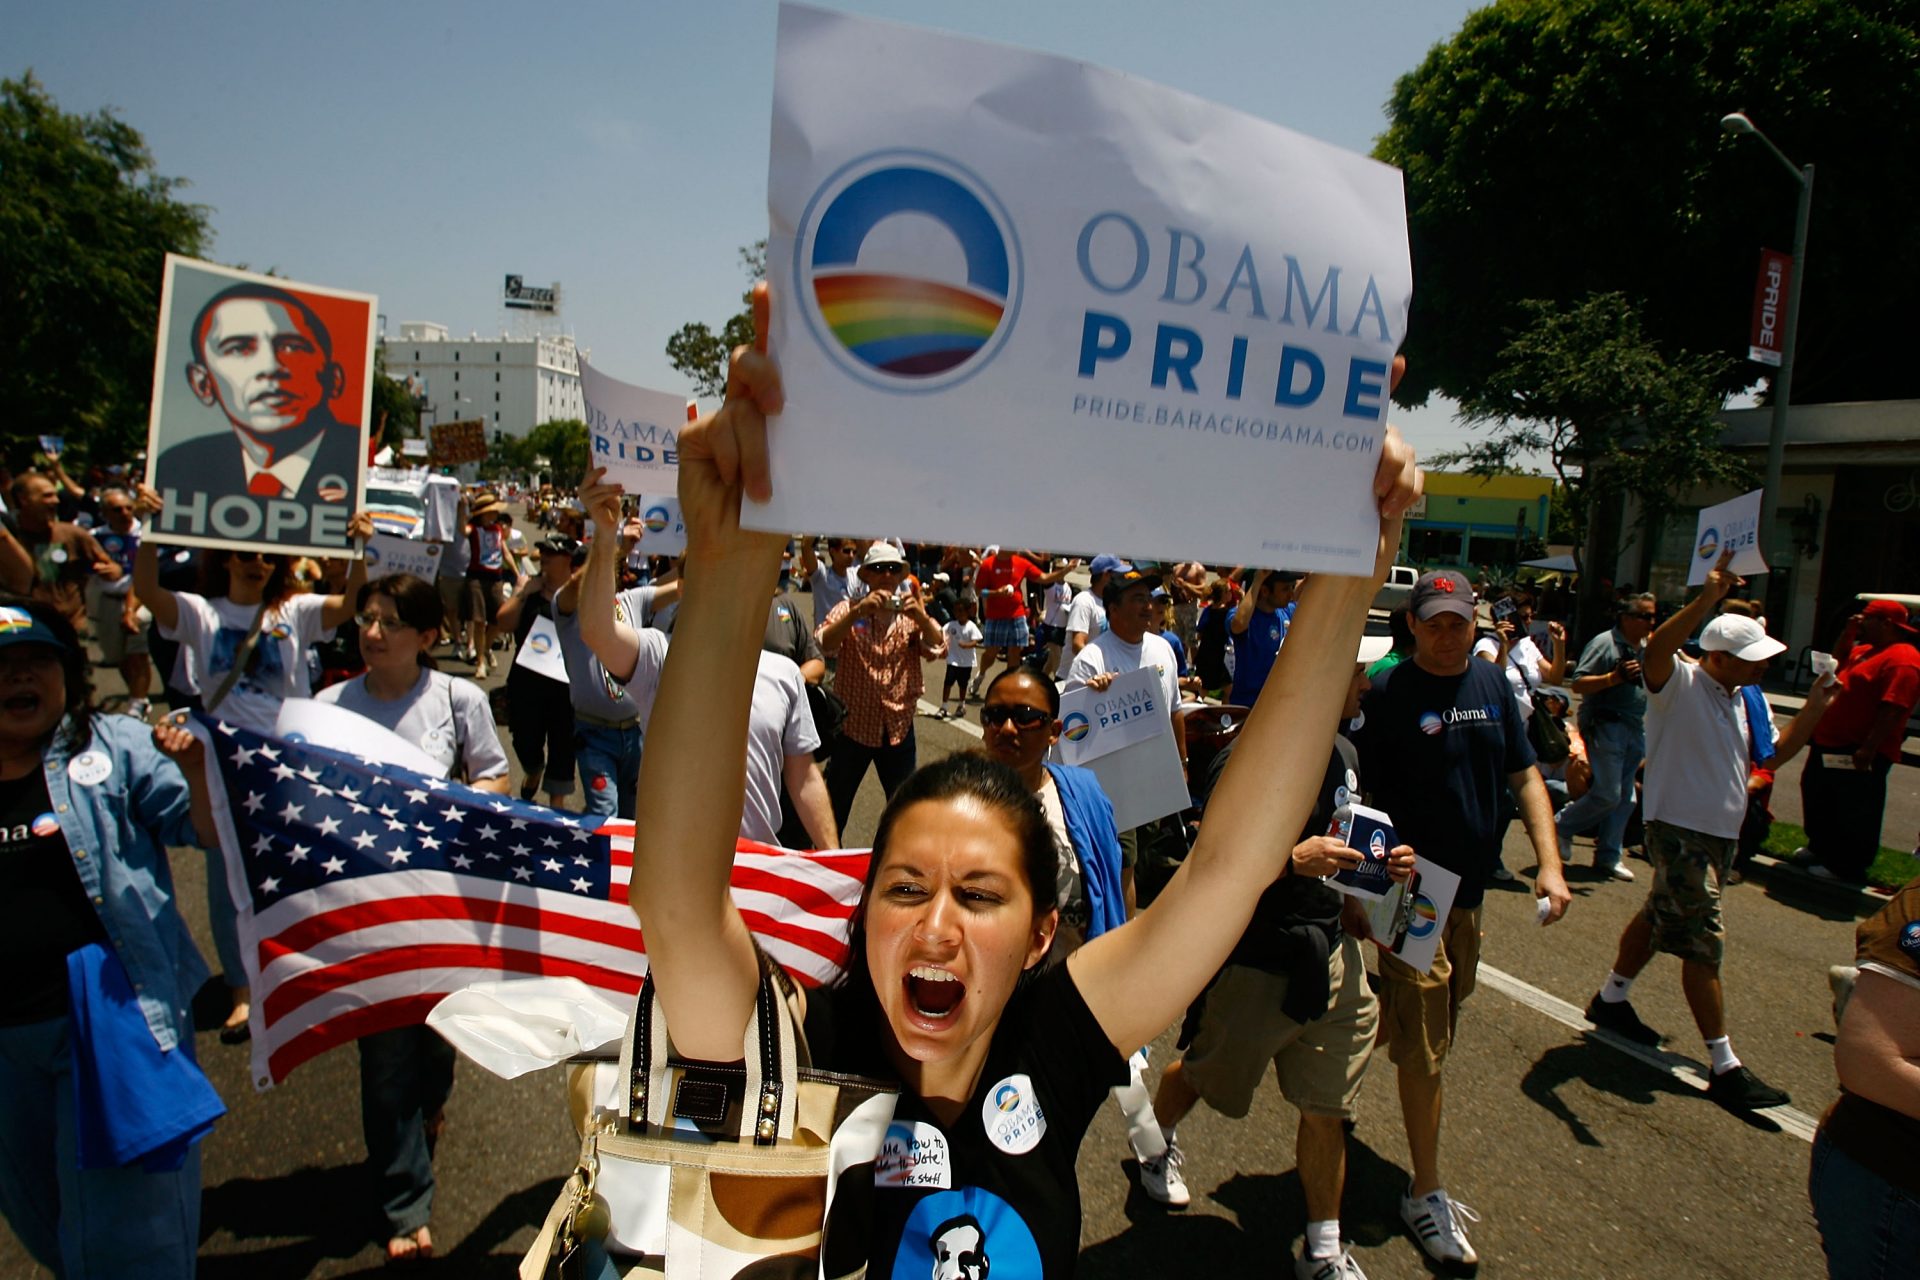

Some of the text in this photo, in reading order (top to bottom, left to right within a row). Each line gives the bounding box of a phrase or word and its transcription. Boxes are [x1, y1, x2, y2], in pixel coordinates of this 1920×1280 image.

[1076, 210, 1393, 344] OBAMA
[1760, 271, 1780, 348] PRIDE
[1077, 309, 1387, 421] PRIDE
[1073, 393, 1374, 453] PRIDE.BARACKOBAMA.COM
[594, 434, 679, 466] RIDE
[160, 487, 349, 547] HOPE
[1094, 688, 1151, 716] OBAMA
[1100, 700, 1154, 728] PRIDE
[934, 1135, 943, 1149] to
[1004, 1109, 1044, 1145] PRIDE
[914, 1150, 944, 1166] Vote!
